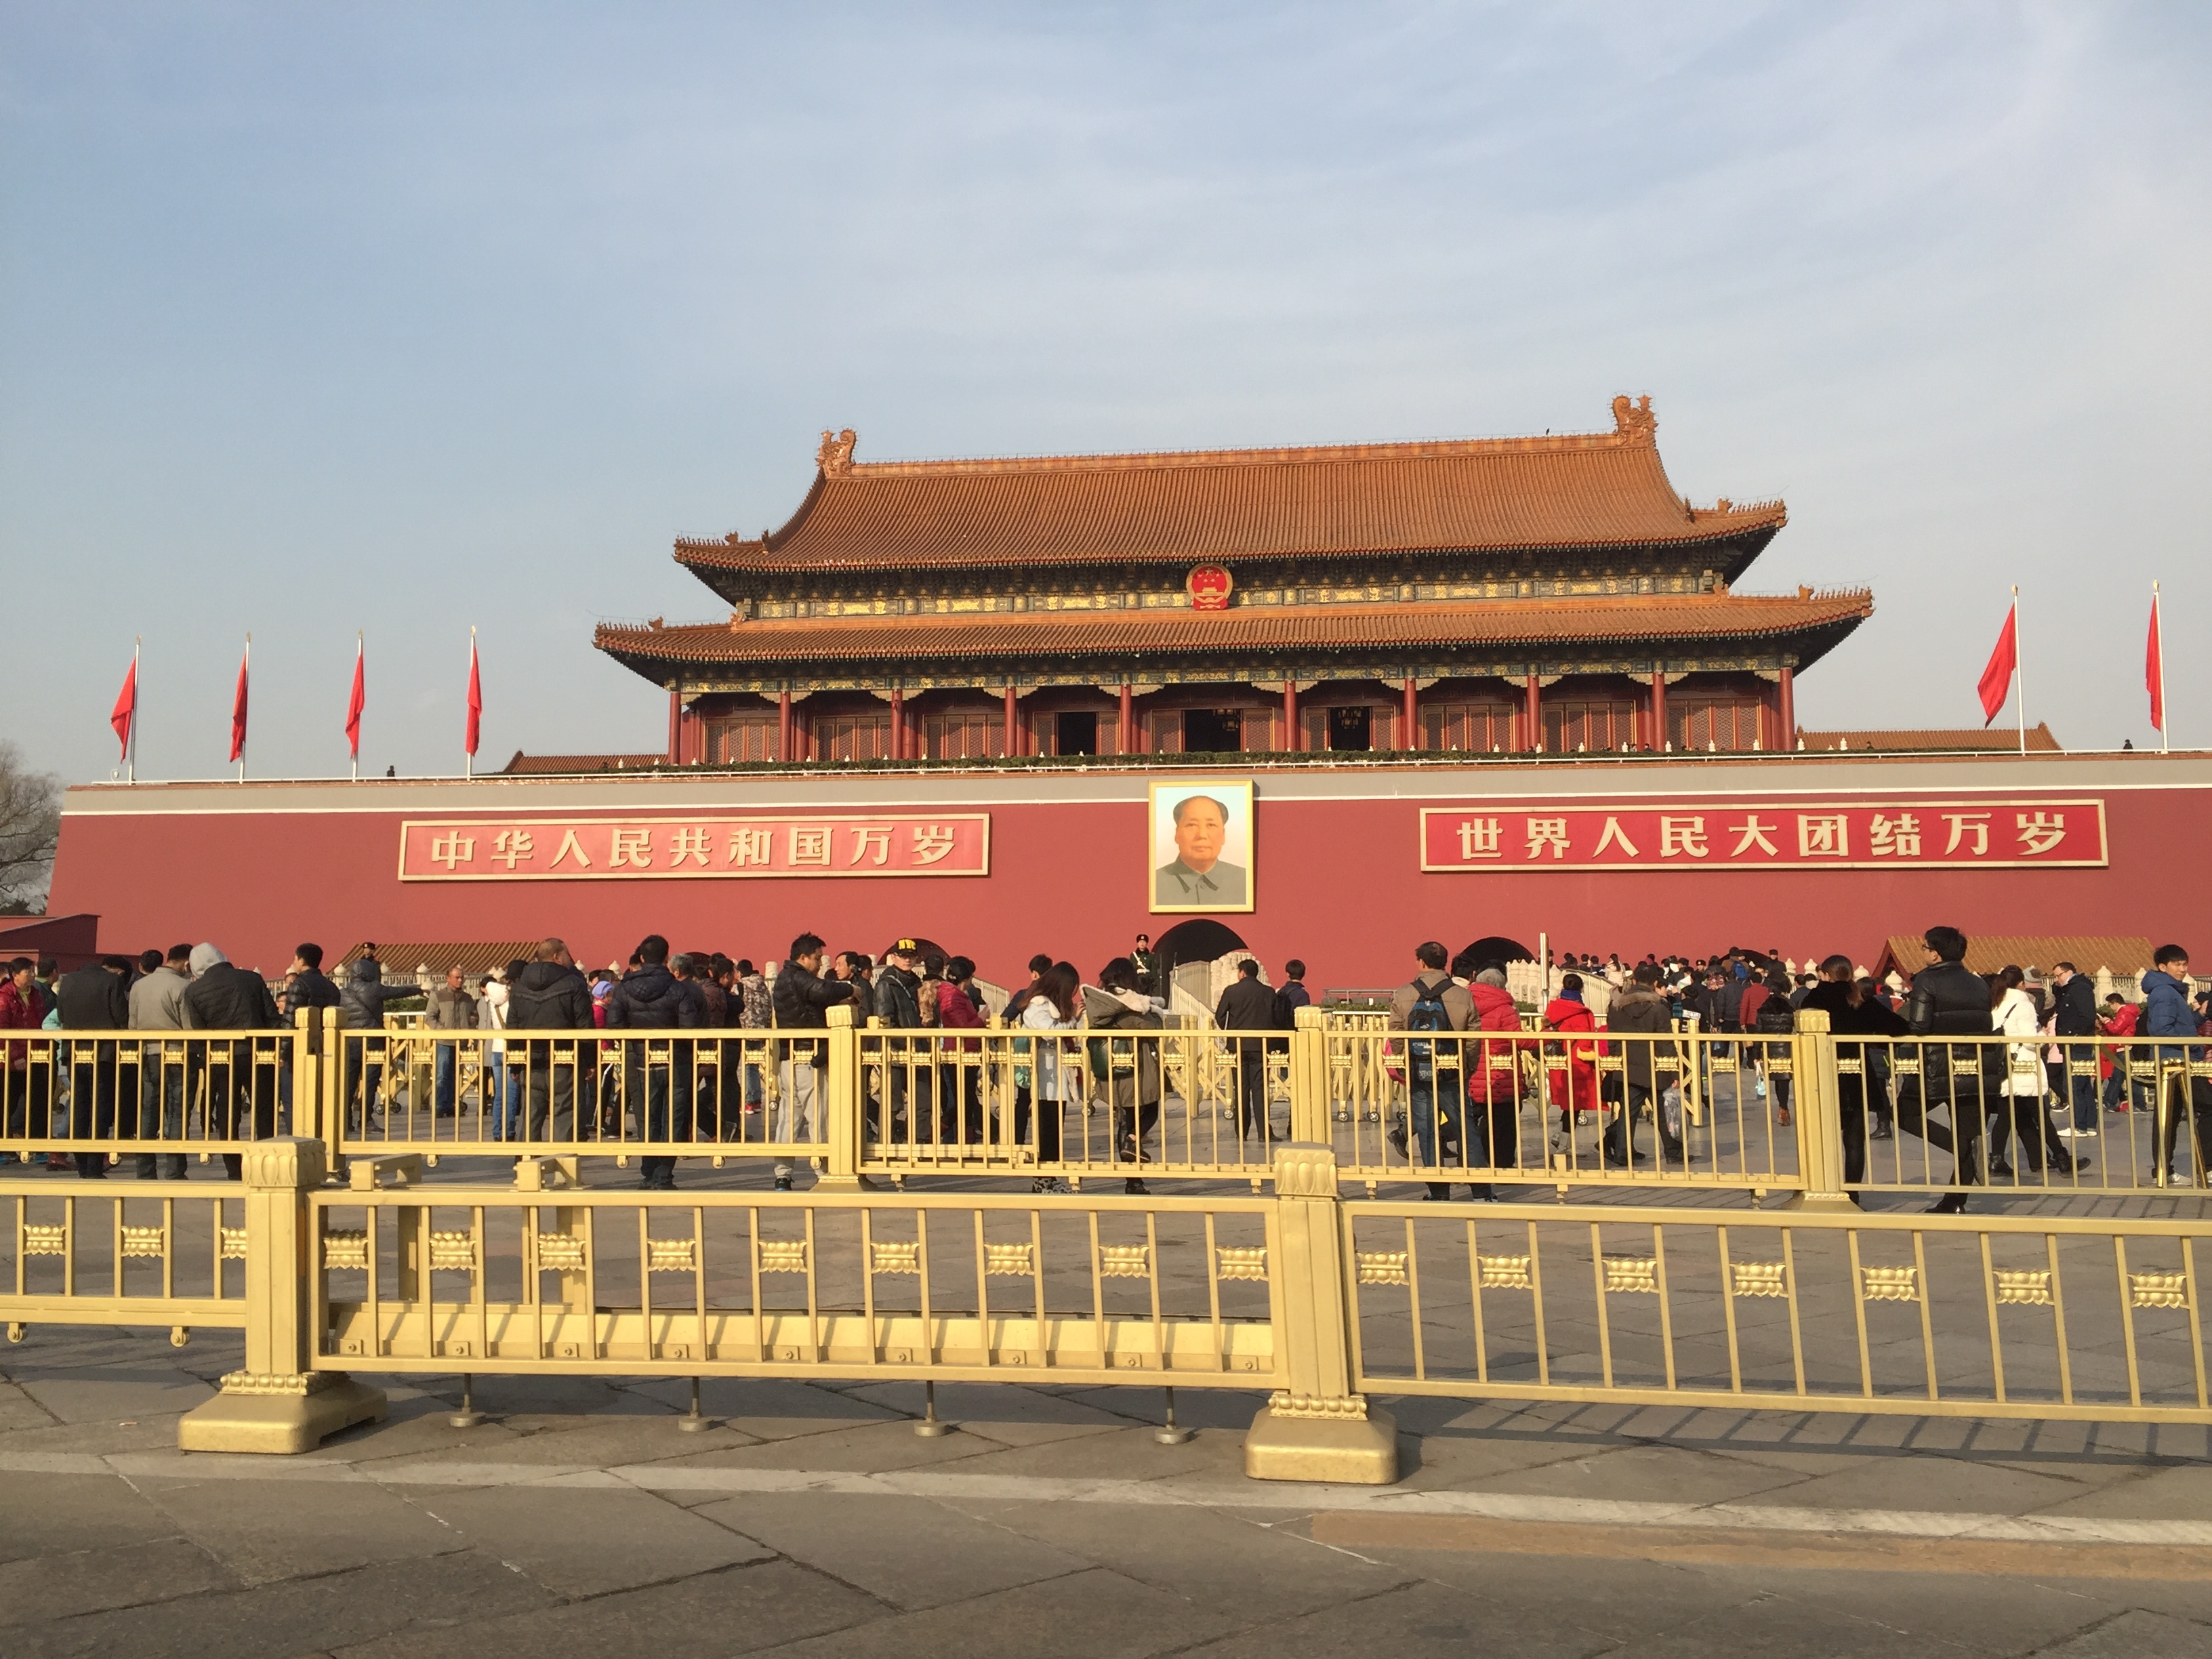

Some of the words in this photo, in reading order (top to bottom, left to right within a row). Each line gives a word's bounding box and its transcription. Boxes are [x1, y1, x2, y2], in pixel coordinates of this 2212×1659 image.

[432, 825, 955, 869] 中华人民共和国万岁
[1456, 811, 2066, 859] 世界人民大团结万岁
